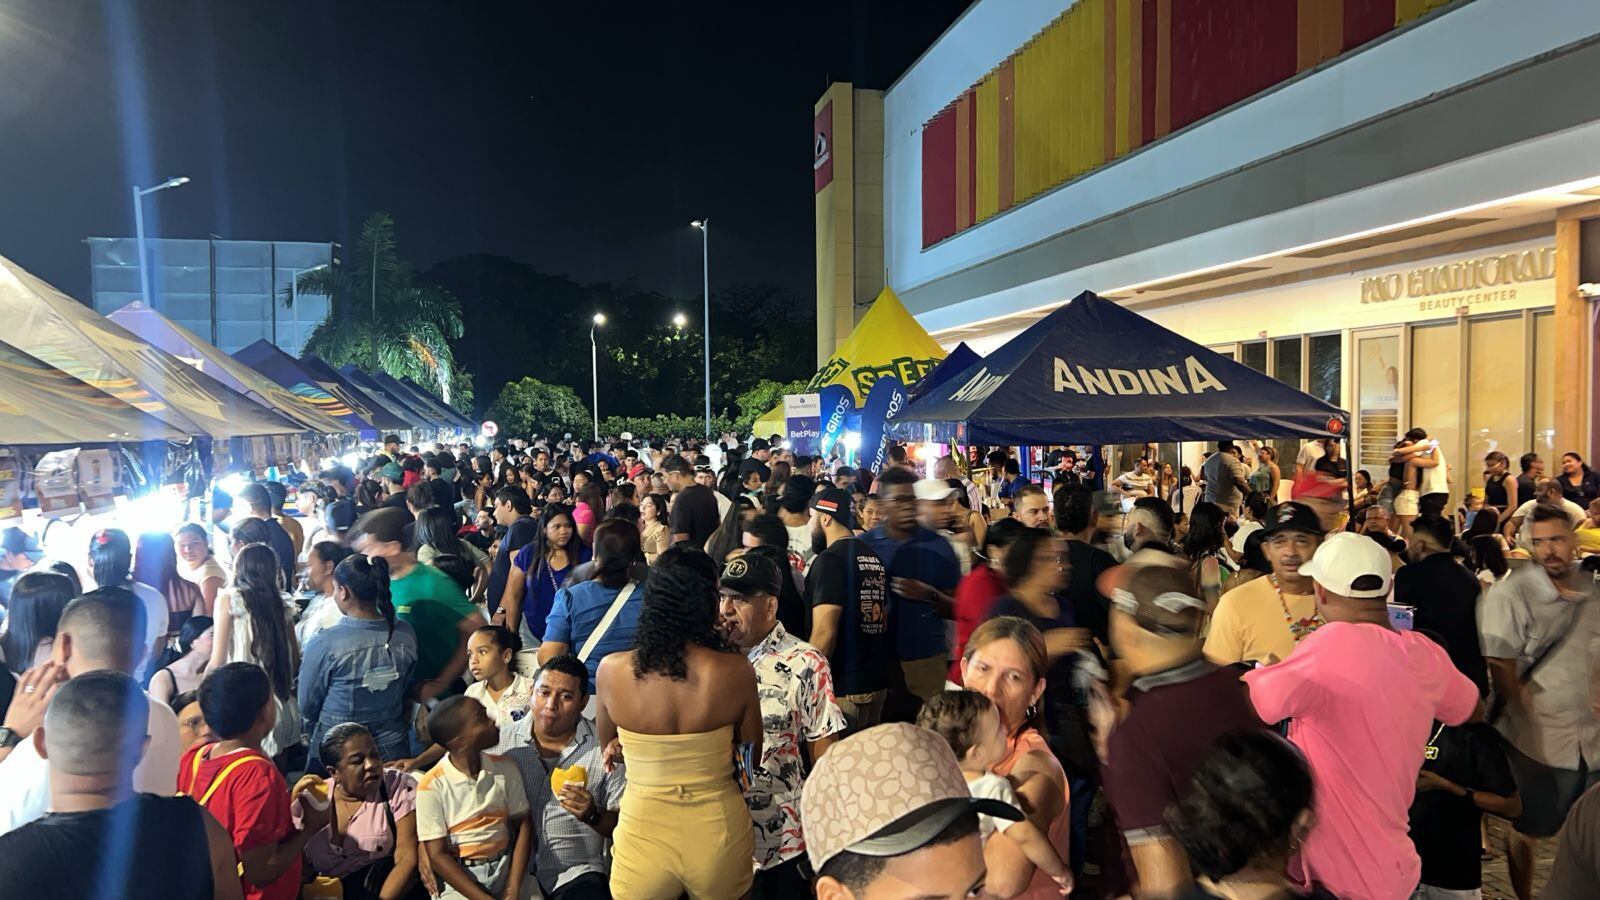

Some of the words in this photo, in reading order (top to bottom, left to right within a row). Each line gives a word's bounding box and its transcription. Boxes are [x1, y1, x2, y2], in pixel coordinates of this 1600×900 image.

[1419, 296, 1465, 312] BEAUTY
[1467, 289, 1517, 305] CENTER
[1054, 355, 1227, 395] ANDINA
[790, 429, 820, 438] BetPlay
